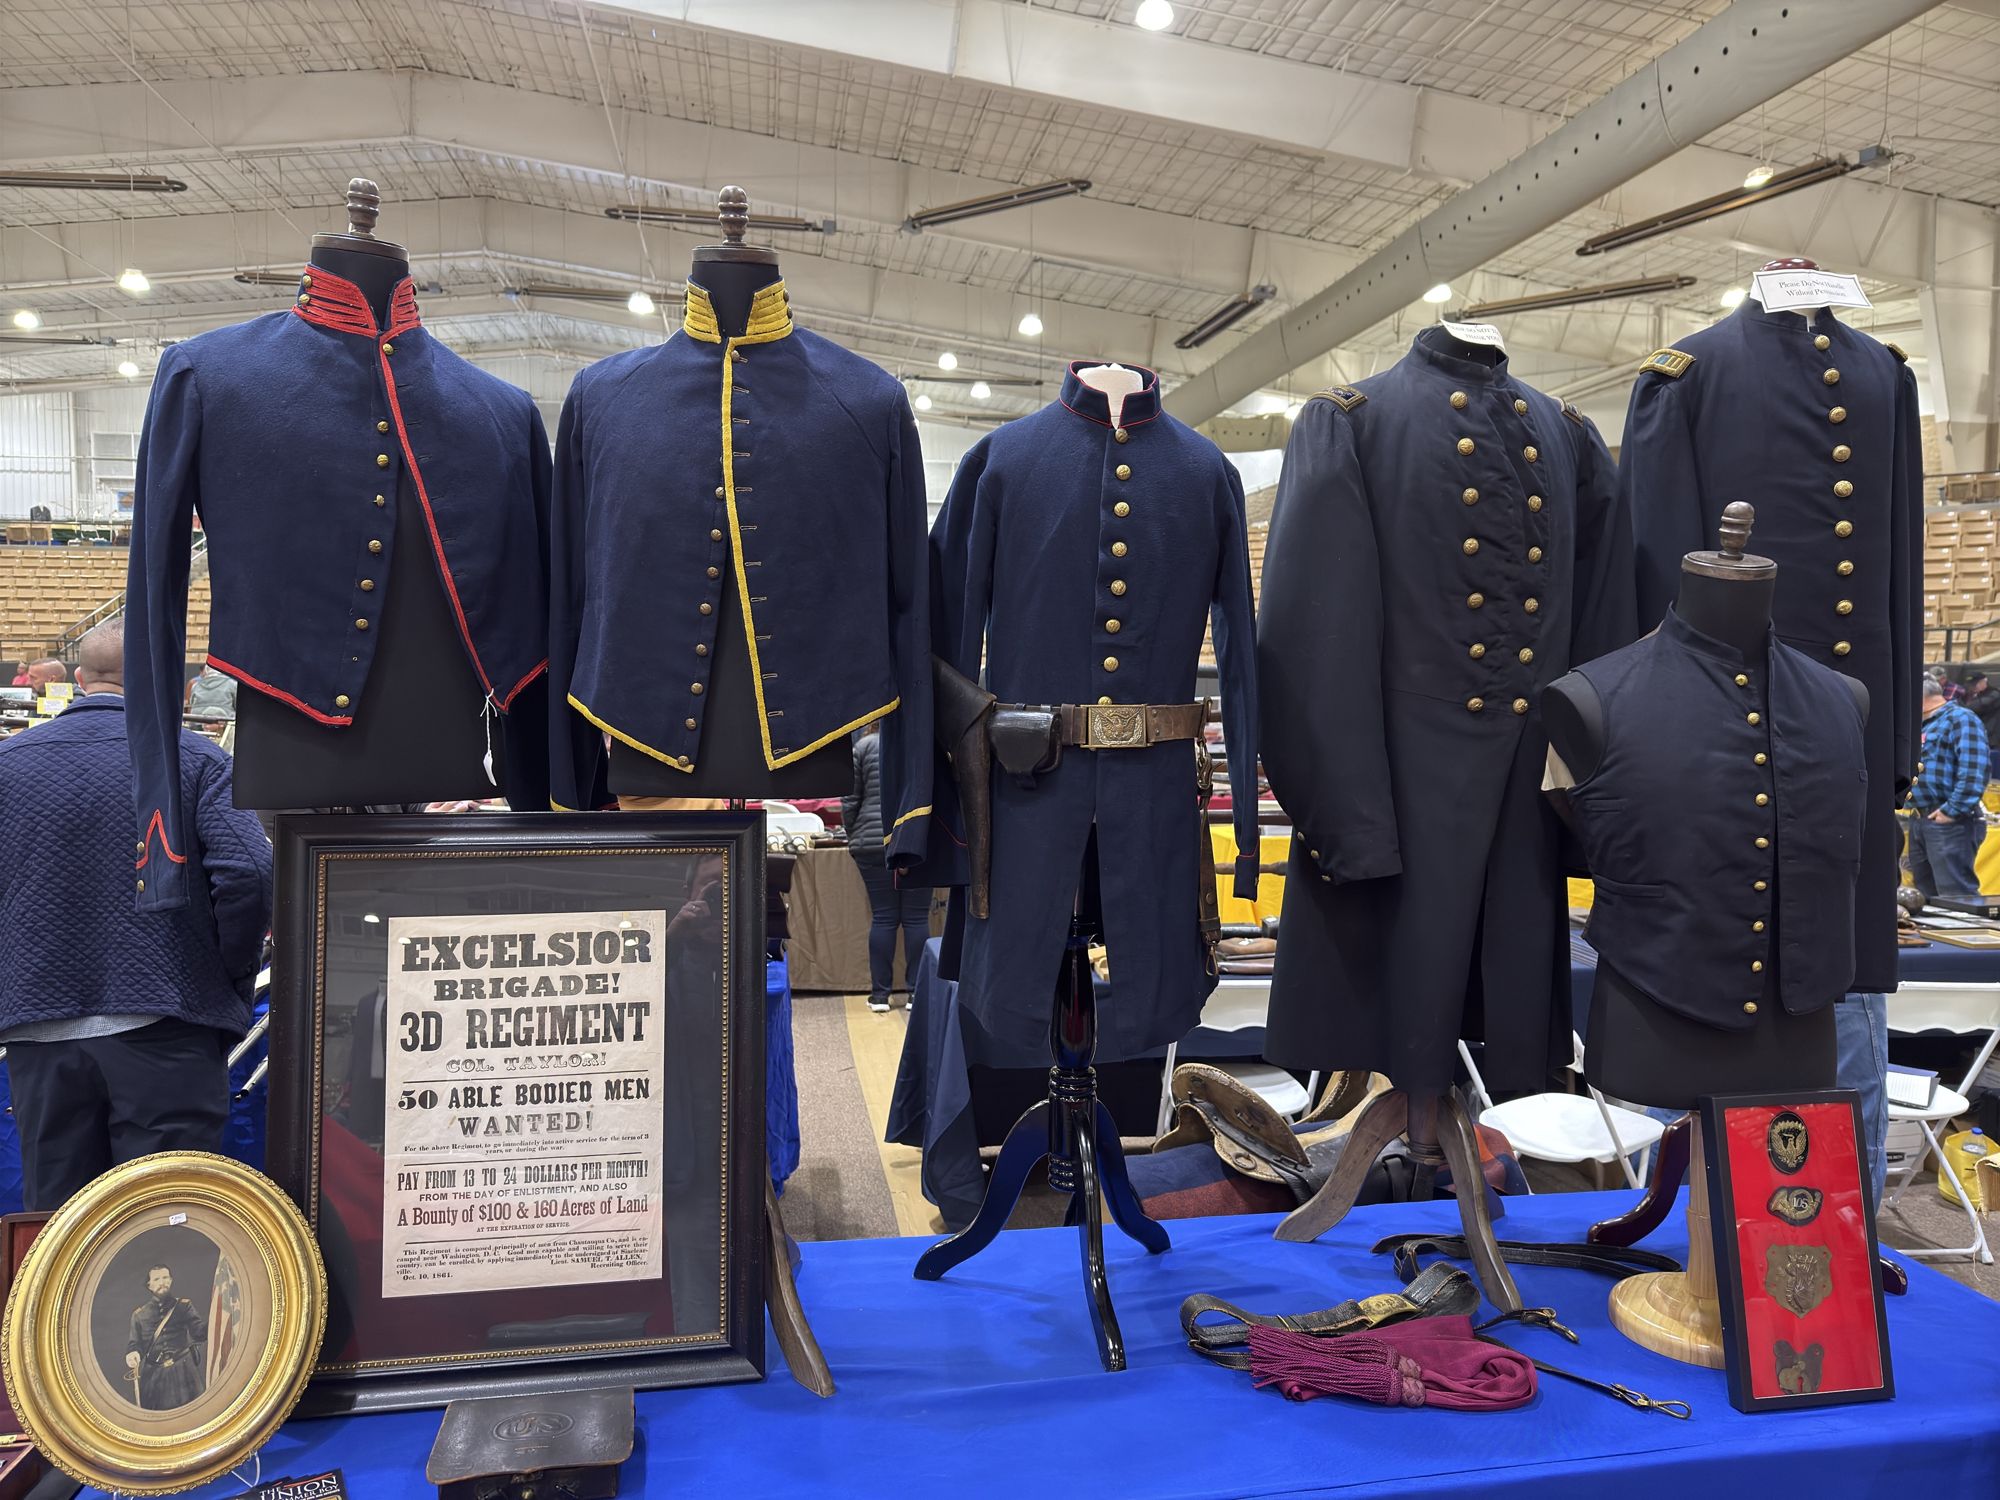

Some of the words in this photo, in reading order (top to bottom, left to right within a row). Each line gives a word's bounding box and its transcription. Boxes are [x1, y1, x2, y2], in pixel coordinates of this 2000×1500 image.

[1779, 280, 1800, 288] Please
[401, 930, 651, 972] EXCELSIOR
[433, 973, 621, 1001] BRIGADE!
[400, 1011, 443, 1052] 3D
[466, 1002, 650, 1049] REGIMENT
[446, 1059, 495, 1073] COL.
[504, 1052, 607, 1071] TAYLOR!
[398, 1090, 438, 1110] 50
[448, 1085, 503, 1110] ABLE
[515, 1080, 592, 1106] BODIED
[605, 1078, 650, 1101] MEN
[458, 1111, 593, 1137] WANTED!
[503, 1139, 540, 1148] immediately
[397, 1172, 419, 1191] PAY
[425, 1170, 456, 1189] FROM
[463, 1169, 475, 1187] 13
[482, 1168, 497, 1186] TO
[503, 1167, 517, 1185] 24
[524, 1163, 578, 1183] DOLLARS
[581, 1162, 602, 1180] PER
[606, 1160, 648, 1179] MONTH!
[420, 1193, 448, 1201] FROM
[452, 1191, 471, 1200] THE
[474, 1190, 494, 1199] DAY
[497, 1189, 511, 1197] OF
[514, 1185, 577, 1196] ENLISTMENT,
[580, 1184, 599, 1192] AND
[602, 1183, 627, 1191] ALSO
[397, 1209, 408, 1226] A
[412, 1206, 458, 1226] Bounty
[462, 1204, 475, 1223] of
[479, 1202, 511, 1222] $100
[517, 1202, 529, 1219] &
[534, 1199, 558, 1219] 160
[560, 1199, 595, 1217] Acres
[600, 1196, 613, 1214] of
[616, 1194, 649, 1213] Land
[421, 1248, 451, 1256] Regiment
[462, 1245, 491, 1254] composed
[494, 1244, 528, 1252] principally
[516, 1253, 553, 1261] immediately
[260, 1475, 337, 1500] UNION
[319, 1484, 339, 1494] BOY
